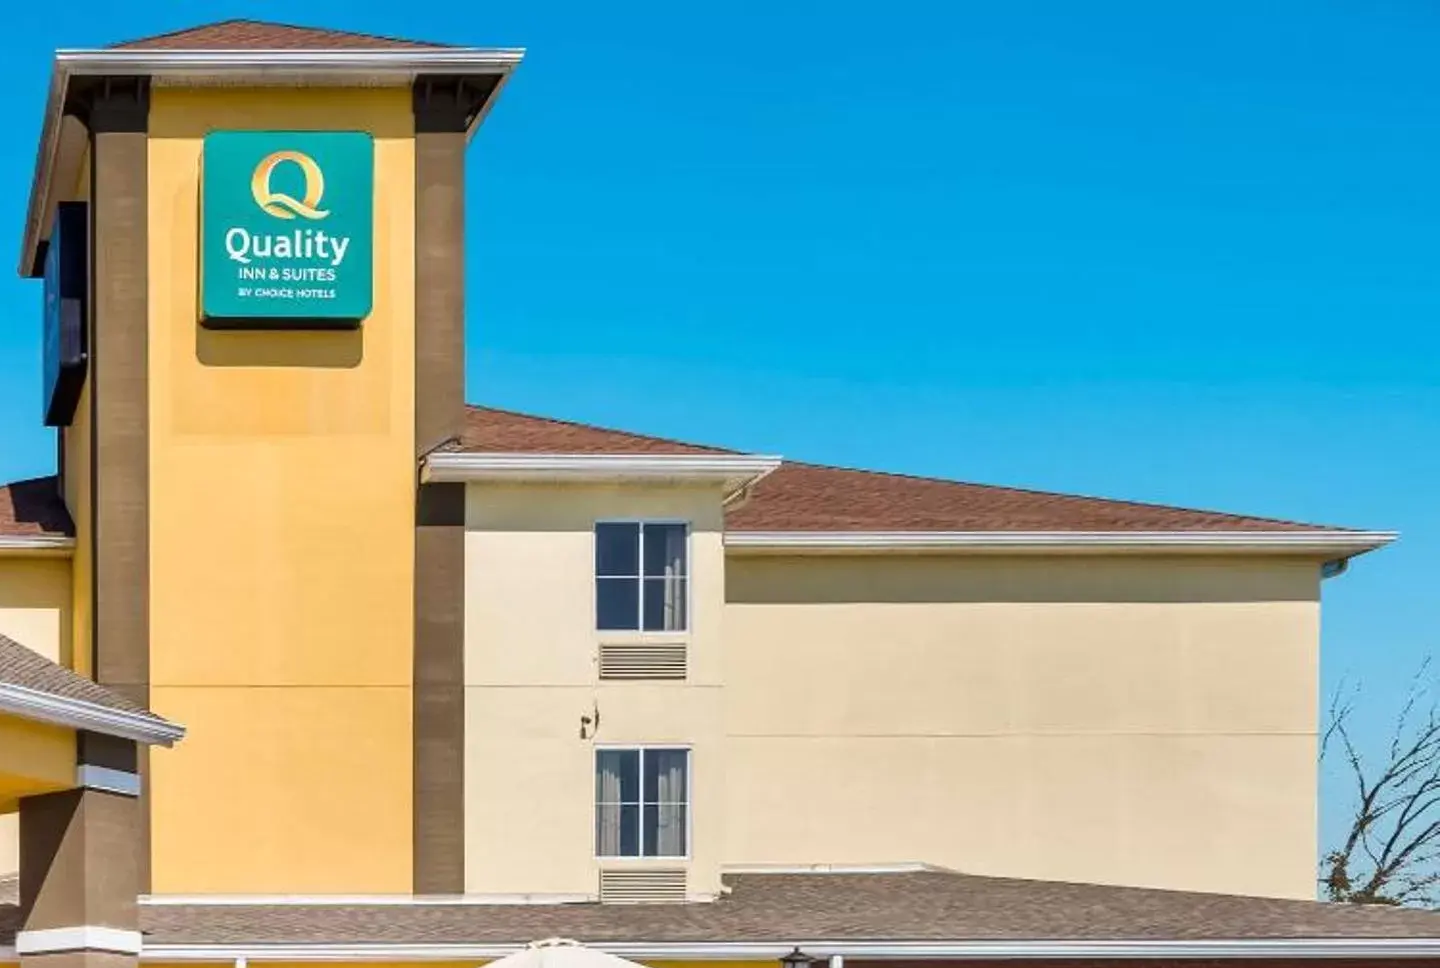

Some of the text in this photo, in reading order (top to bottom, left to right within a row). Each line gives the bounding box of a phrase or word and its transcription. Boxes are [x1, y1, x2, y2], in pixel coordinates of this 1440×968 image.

[251, 150, 331, 220] Q
[225, 227, 350, 266] Quality
[239, 267, 336, 281] INN & SUITES
[238, 287, 336, 299] BY CHOICE HOTELS
